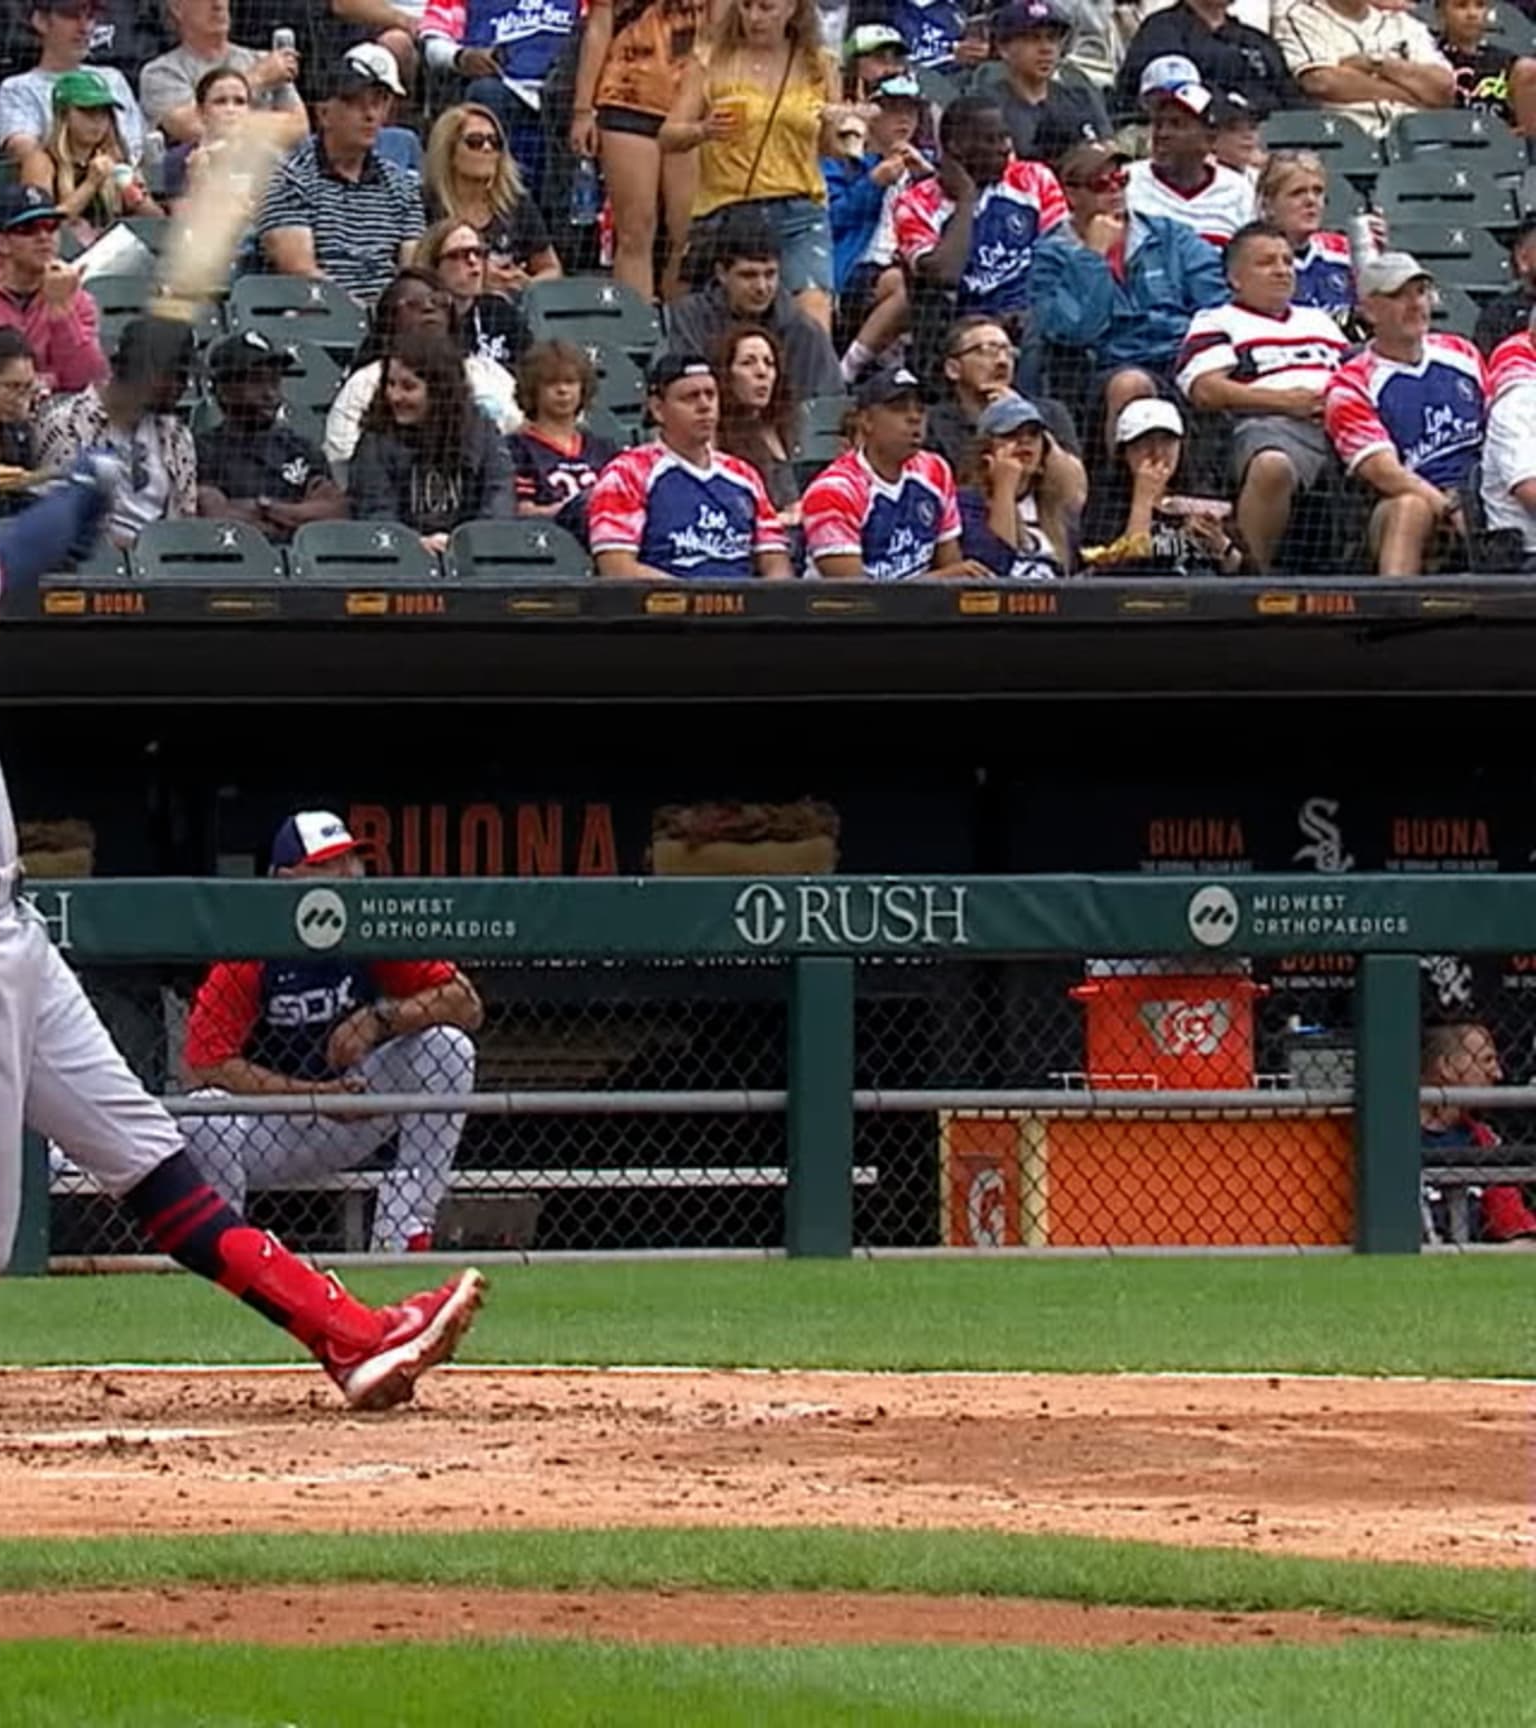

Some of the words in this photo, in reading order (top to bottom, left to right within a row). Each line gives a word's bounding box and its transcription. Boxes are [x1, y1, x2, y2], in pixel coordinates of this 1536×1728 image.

[1149, 819, 1245, 856] BUONA
[1393, 819, 1491, 855] BUONA
[361, 899, 455, 914] MIDWEST
[795, 884, 969, 944] RUSH
[1252, 896, 1346, 911] MIDWEST
[360, 921, 516, 937] ORTHOPAEDICS
[1252, 917, 1409, 934] ORTHOPAEDICS
[265, 975, 357, 1026] SOX
